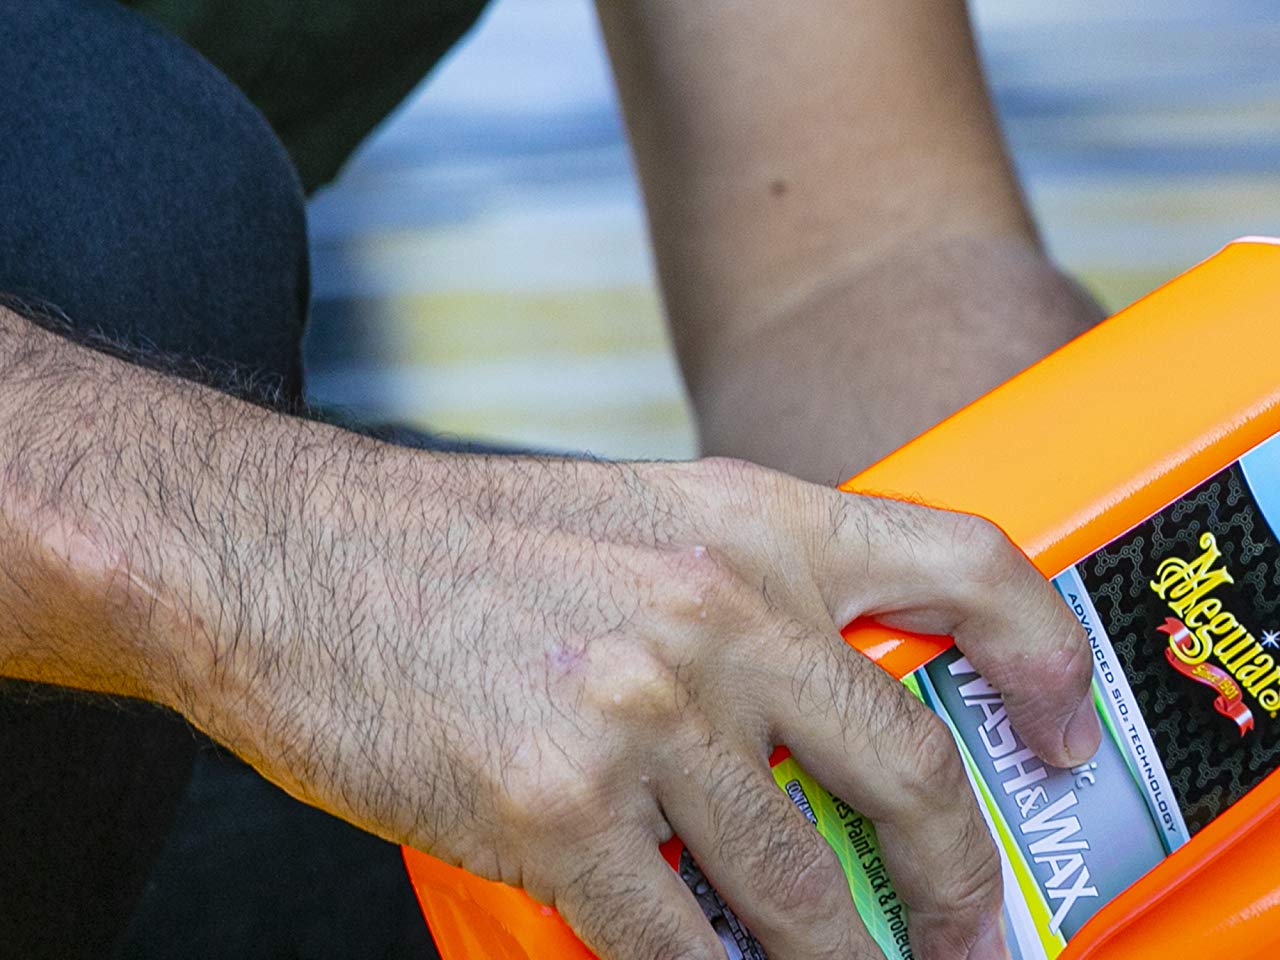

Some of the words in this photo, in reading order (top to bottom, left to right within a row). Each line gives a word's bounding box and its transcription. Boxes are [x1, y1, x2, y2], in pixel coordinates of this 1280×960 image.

[1068, 592, 1114, 684] ADVANCED
[1128, 724, 1177, 833] TECHNOLOGY
[1217, 677, 1239, 700] 1901
[844, 815, 875, 860] Paint
[863, 856, 890, 895] Slick
[878, 892, 897, 908] &
